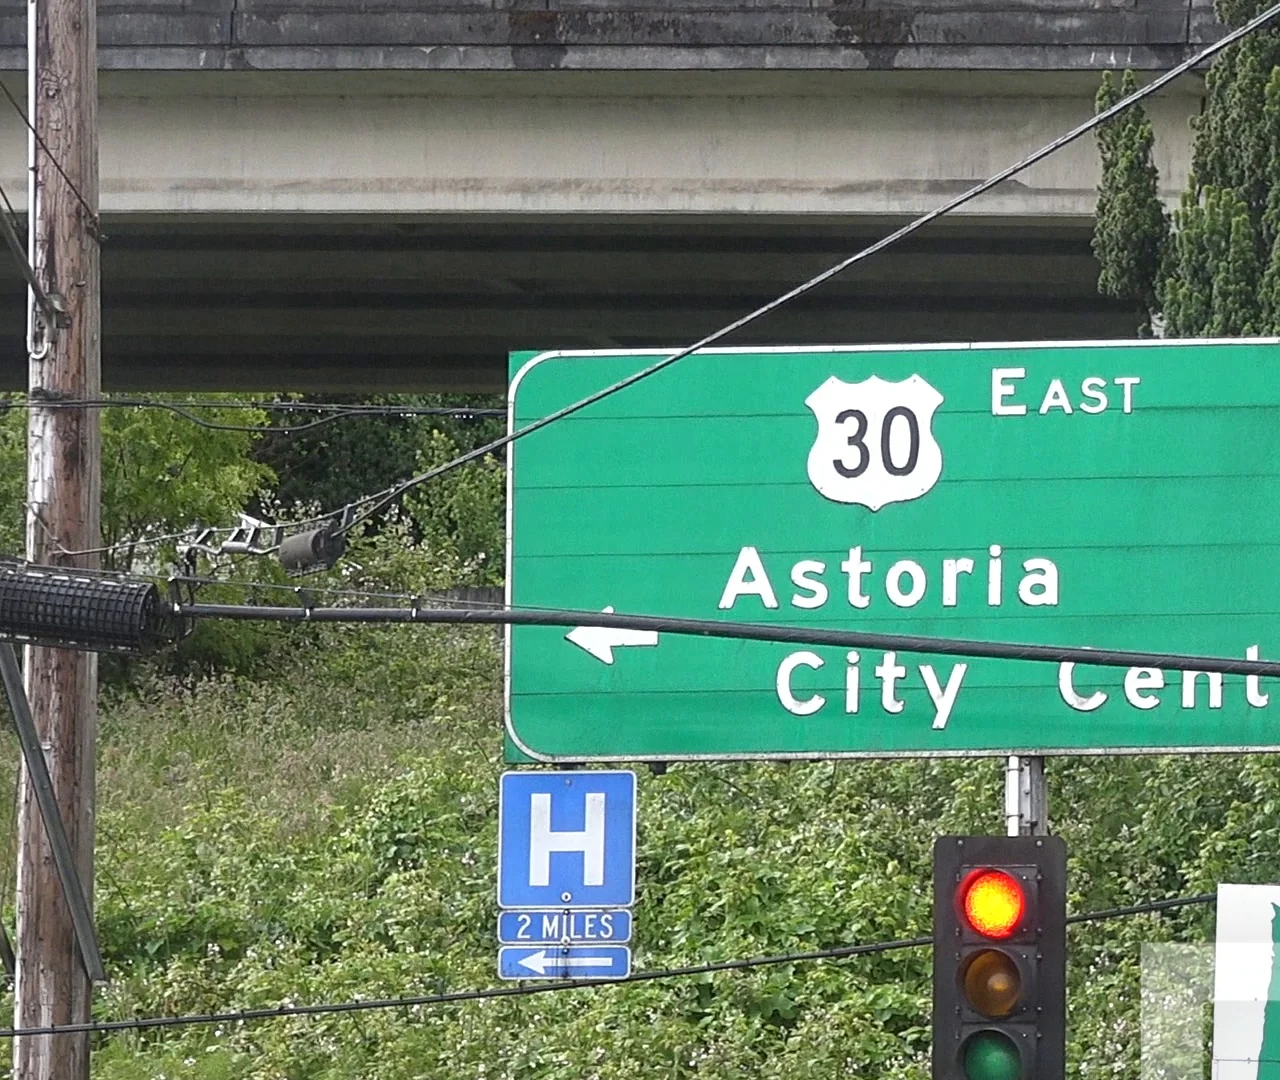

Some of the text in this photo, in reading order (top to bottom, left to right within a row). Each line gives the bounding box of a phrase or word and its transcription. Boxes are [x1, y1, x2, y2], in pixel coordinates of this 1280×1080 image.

[990, 367, 1141, 416] EAST
[831, 405, 922, 478] 30
[718, 544, 1061, 609] Astoria
[776, 650, 968, 730] City
[529, 793, 605, 886] H
[517, 914, 614, 939] 2 MILES
